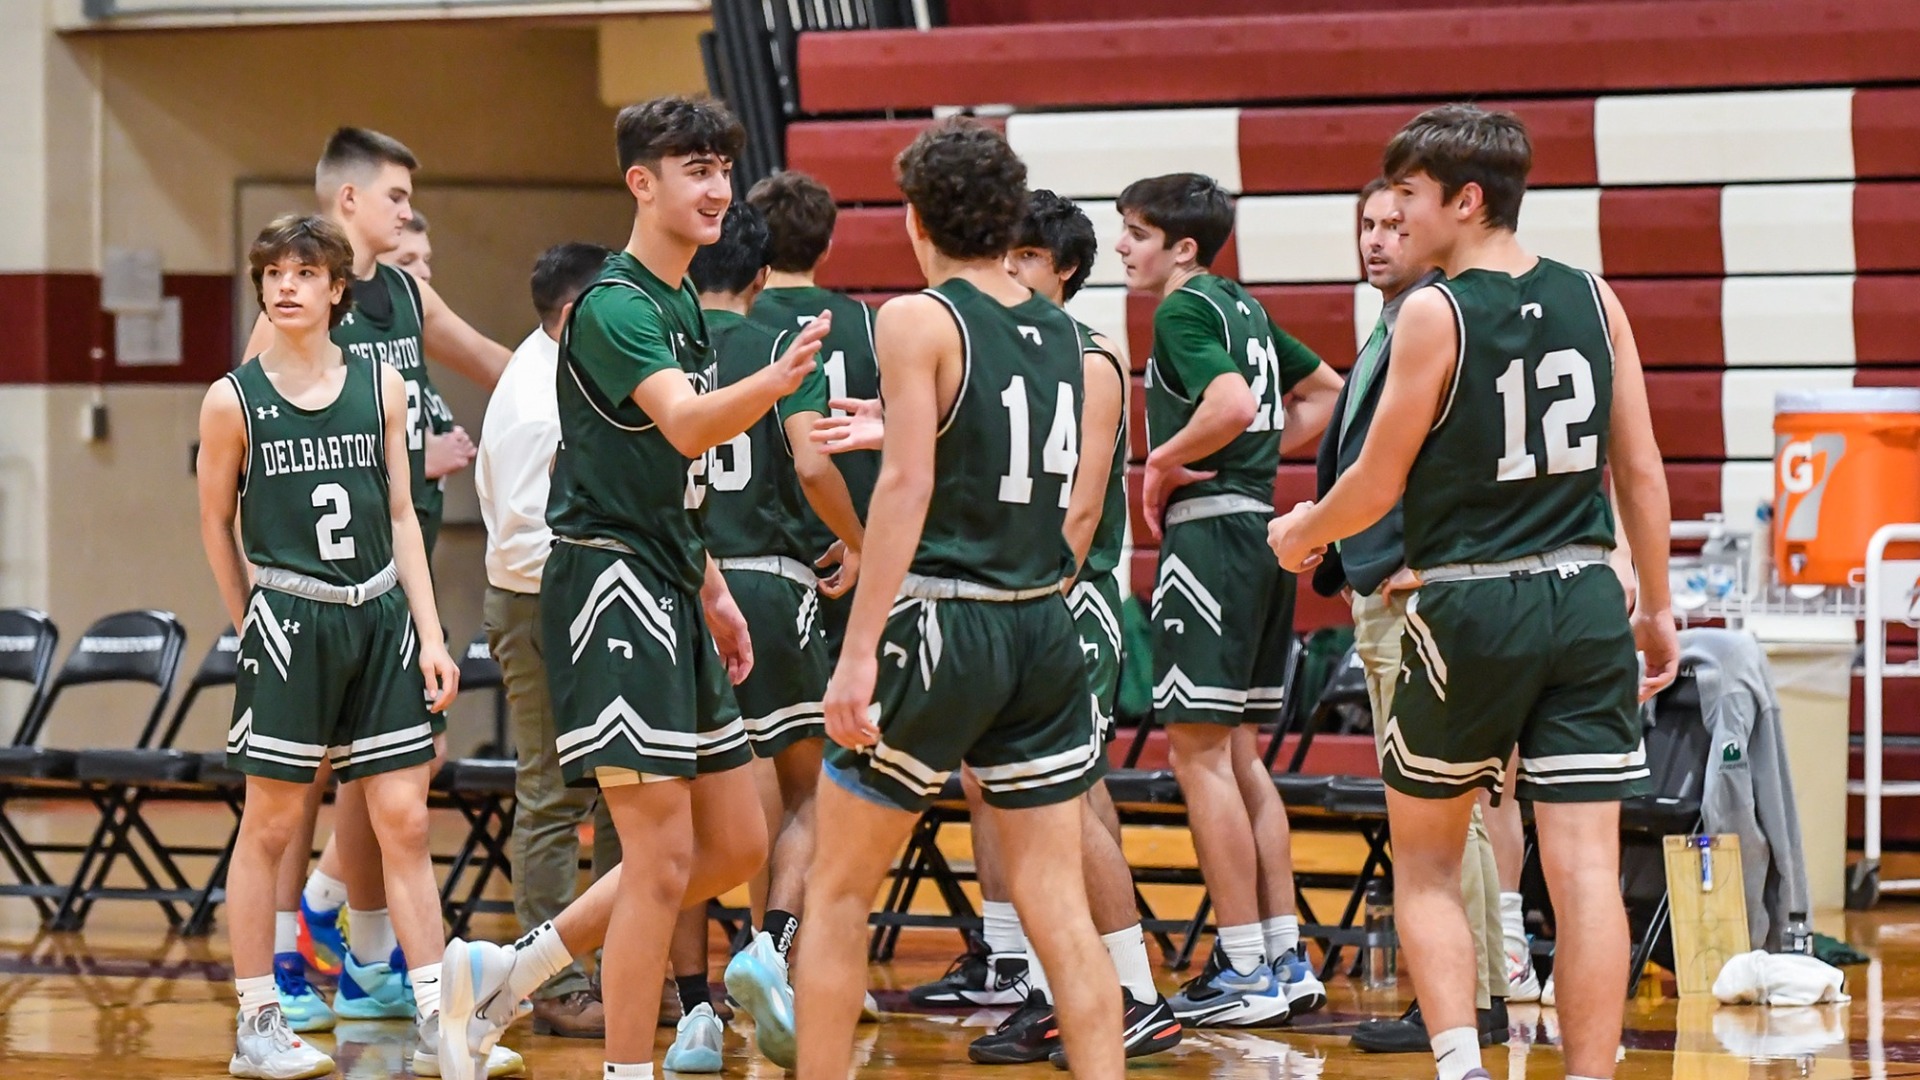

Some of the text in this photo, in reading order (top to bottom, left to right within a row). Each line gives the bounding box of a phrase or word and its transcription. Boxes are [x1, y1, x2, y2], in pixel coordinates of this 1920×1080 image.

[1246, 336, 1284, 432] 21
[1495, 348, 1598, 482] 12
[260, 433, 377, 476] DELBARTON
[998, 374, 1078, 509] 14
[1781, 440, 1813, 494] G
[311, 482, 356, 560] 2
